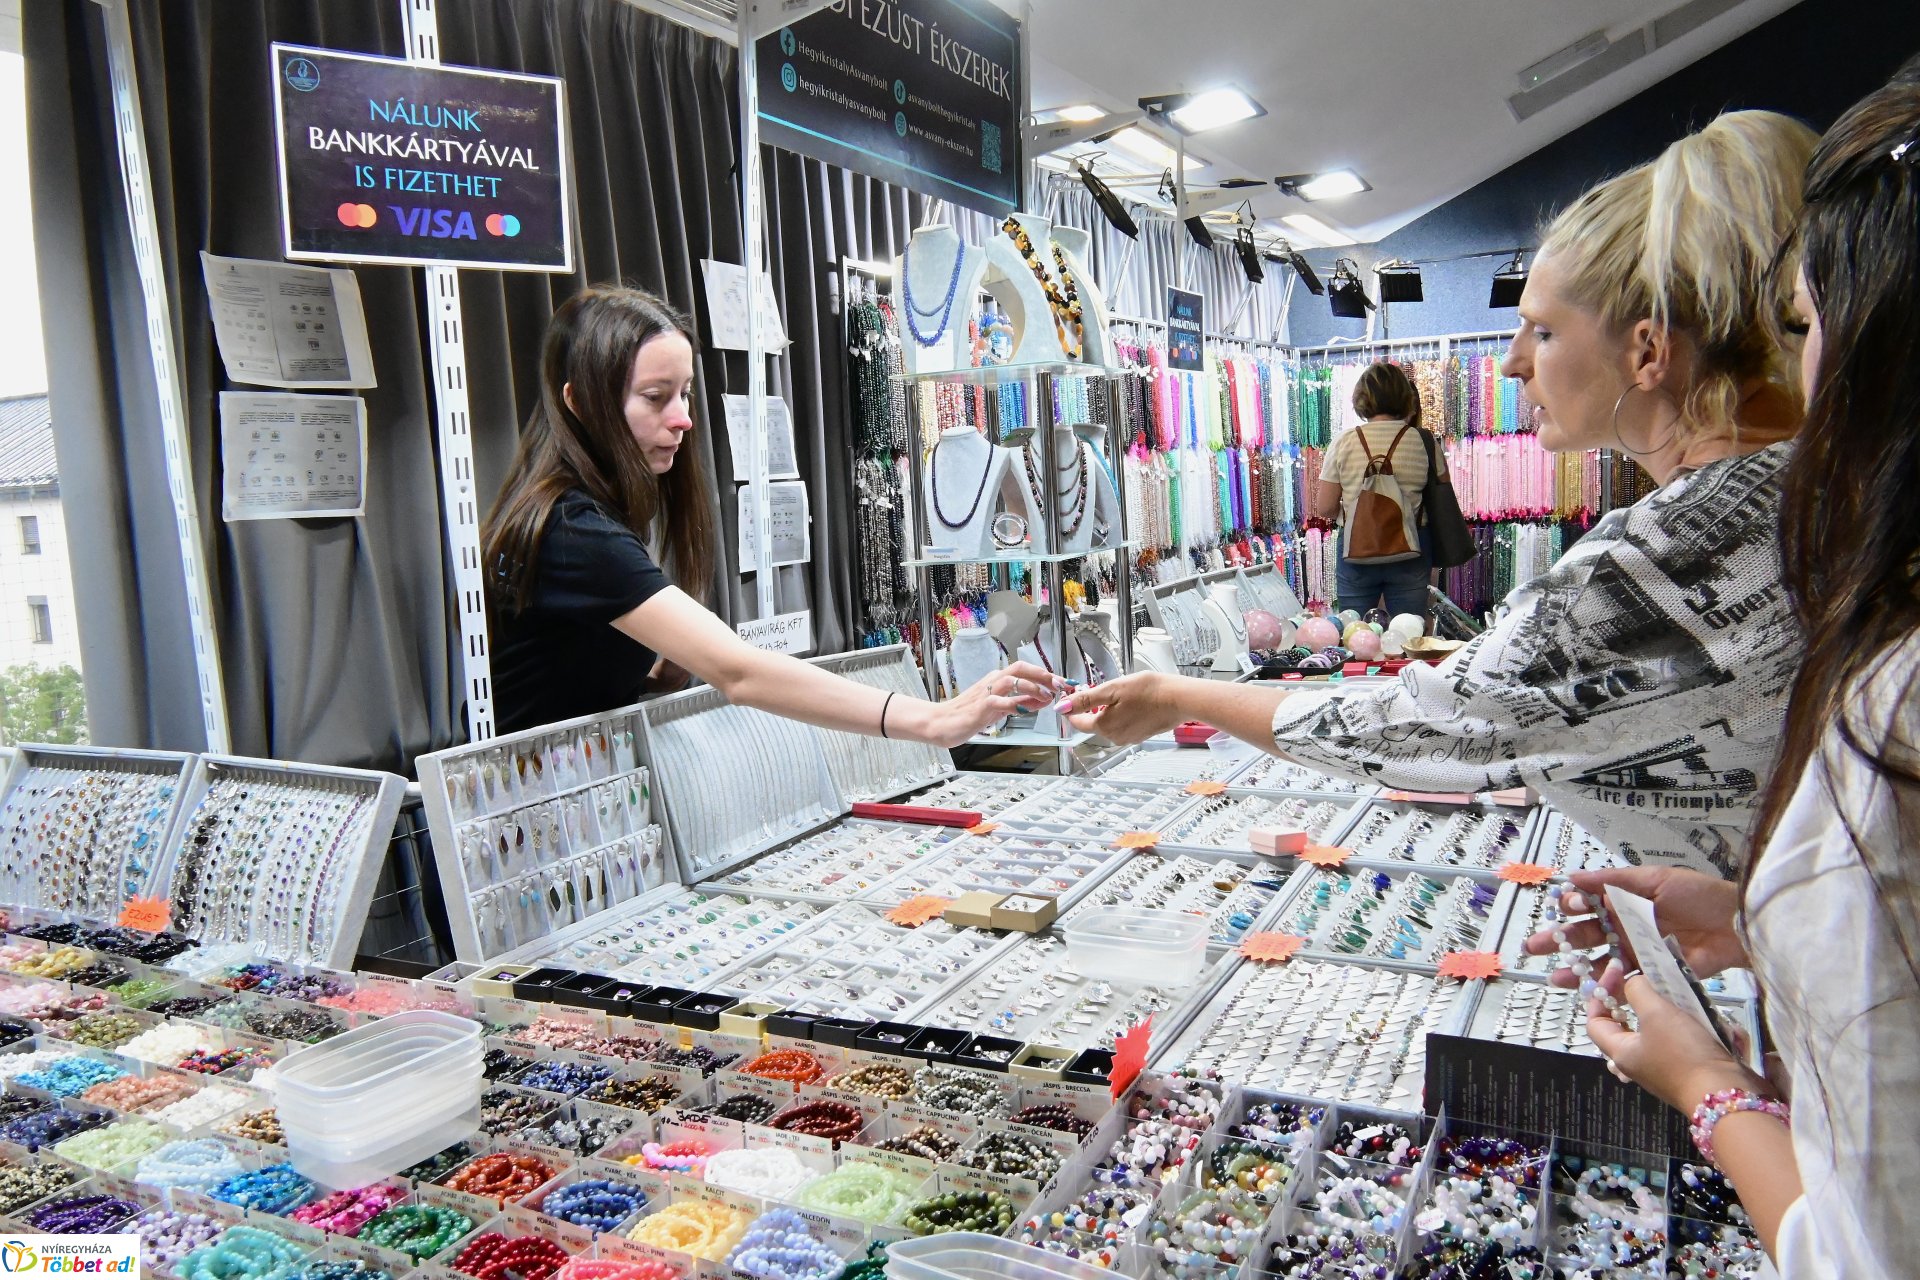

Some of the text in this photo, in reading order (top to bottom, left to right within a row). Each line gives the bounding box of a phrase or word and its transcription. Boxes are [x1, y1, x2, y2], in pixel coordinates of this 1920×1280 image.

[860, 0, 1011, 101] EZÜST ÉKSZEREK
[369, 97, 482, 132] NÁLUNK
[309, 126, 539, 170] BANKKÁRTYÁVAL
[355, 165, 502, 198] IS FIZETHET
[386, 205, 478, 241] VISA
[787, 617, 804, 631] KFT
[1626, 791, 1646, 807] de
[1651, 792, 1735, 812] Triomphe
